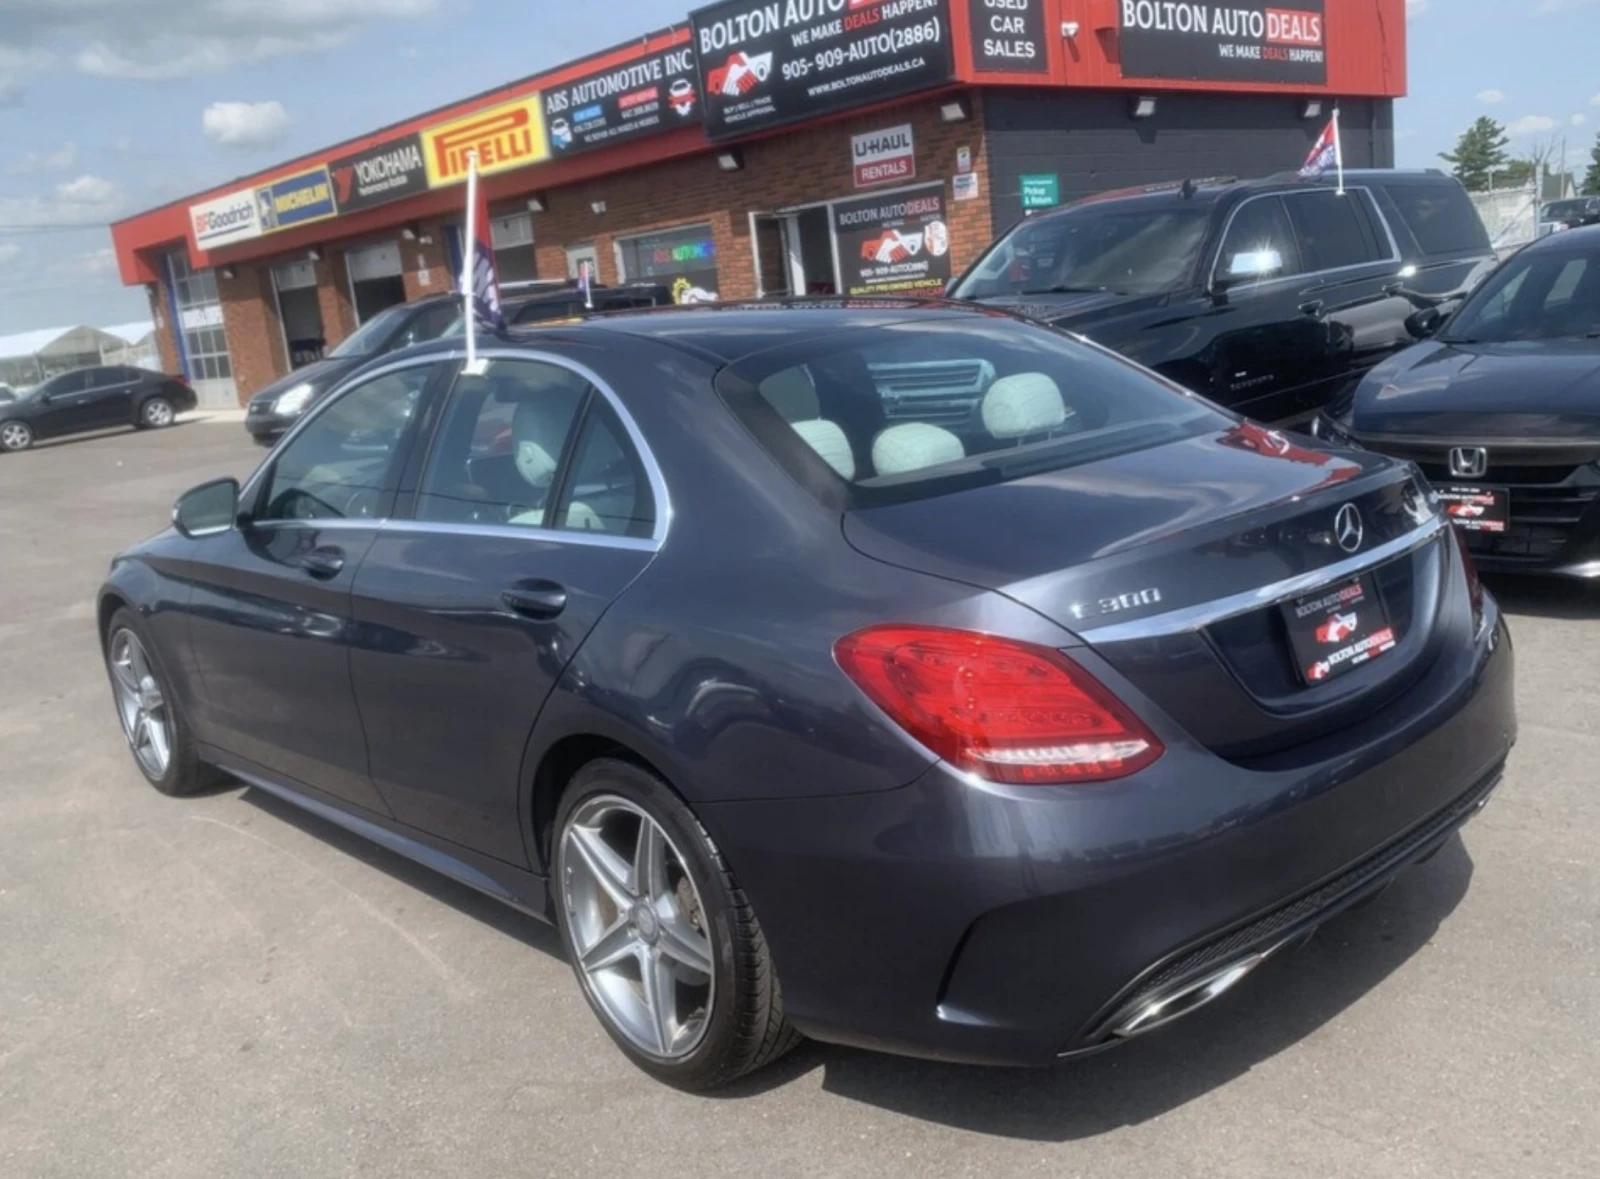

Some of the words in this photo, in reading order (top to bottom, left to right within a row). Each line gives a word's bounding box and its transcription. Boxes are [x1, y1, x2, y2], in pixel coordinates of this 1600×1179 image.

[700, 3, 779, 54] BOLTON
[791, 31, 809, 47] WE
[810, 19, 843, 42] MAKE
[844, 7, 880, 31] DEALS
[990, 15, 1025, 34] CAR
[1122, 0, 1208, 34] BOLTON
[1211, 7, 1264, 38] AUTO
[1266, 13, 1321, 42] DEALS
[984, 38, 1036, 58] SALES
[1218, 44, 1234, 58] WE
[1235, 44, 1261, 59] MAKE
[547, 90, 569, 114] ABS
[571, 59, 662, 107] AUTOMOTIVE
[664, 48, 694, 77] INC
[855, 133, 910, 157] U-HAUL
[354, 144, 422, 185] YOKOHAMA
[861, 160, 907, 181] RENTALS
[840, 208, 879, 225] BOLTON
